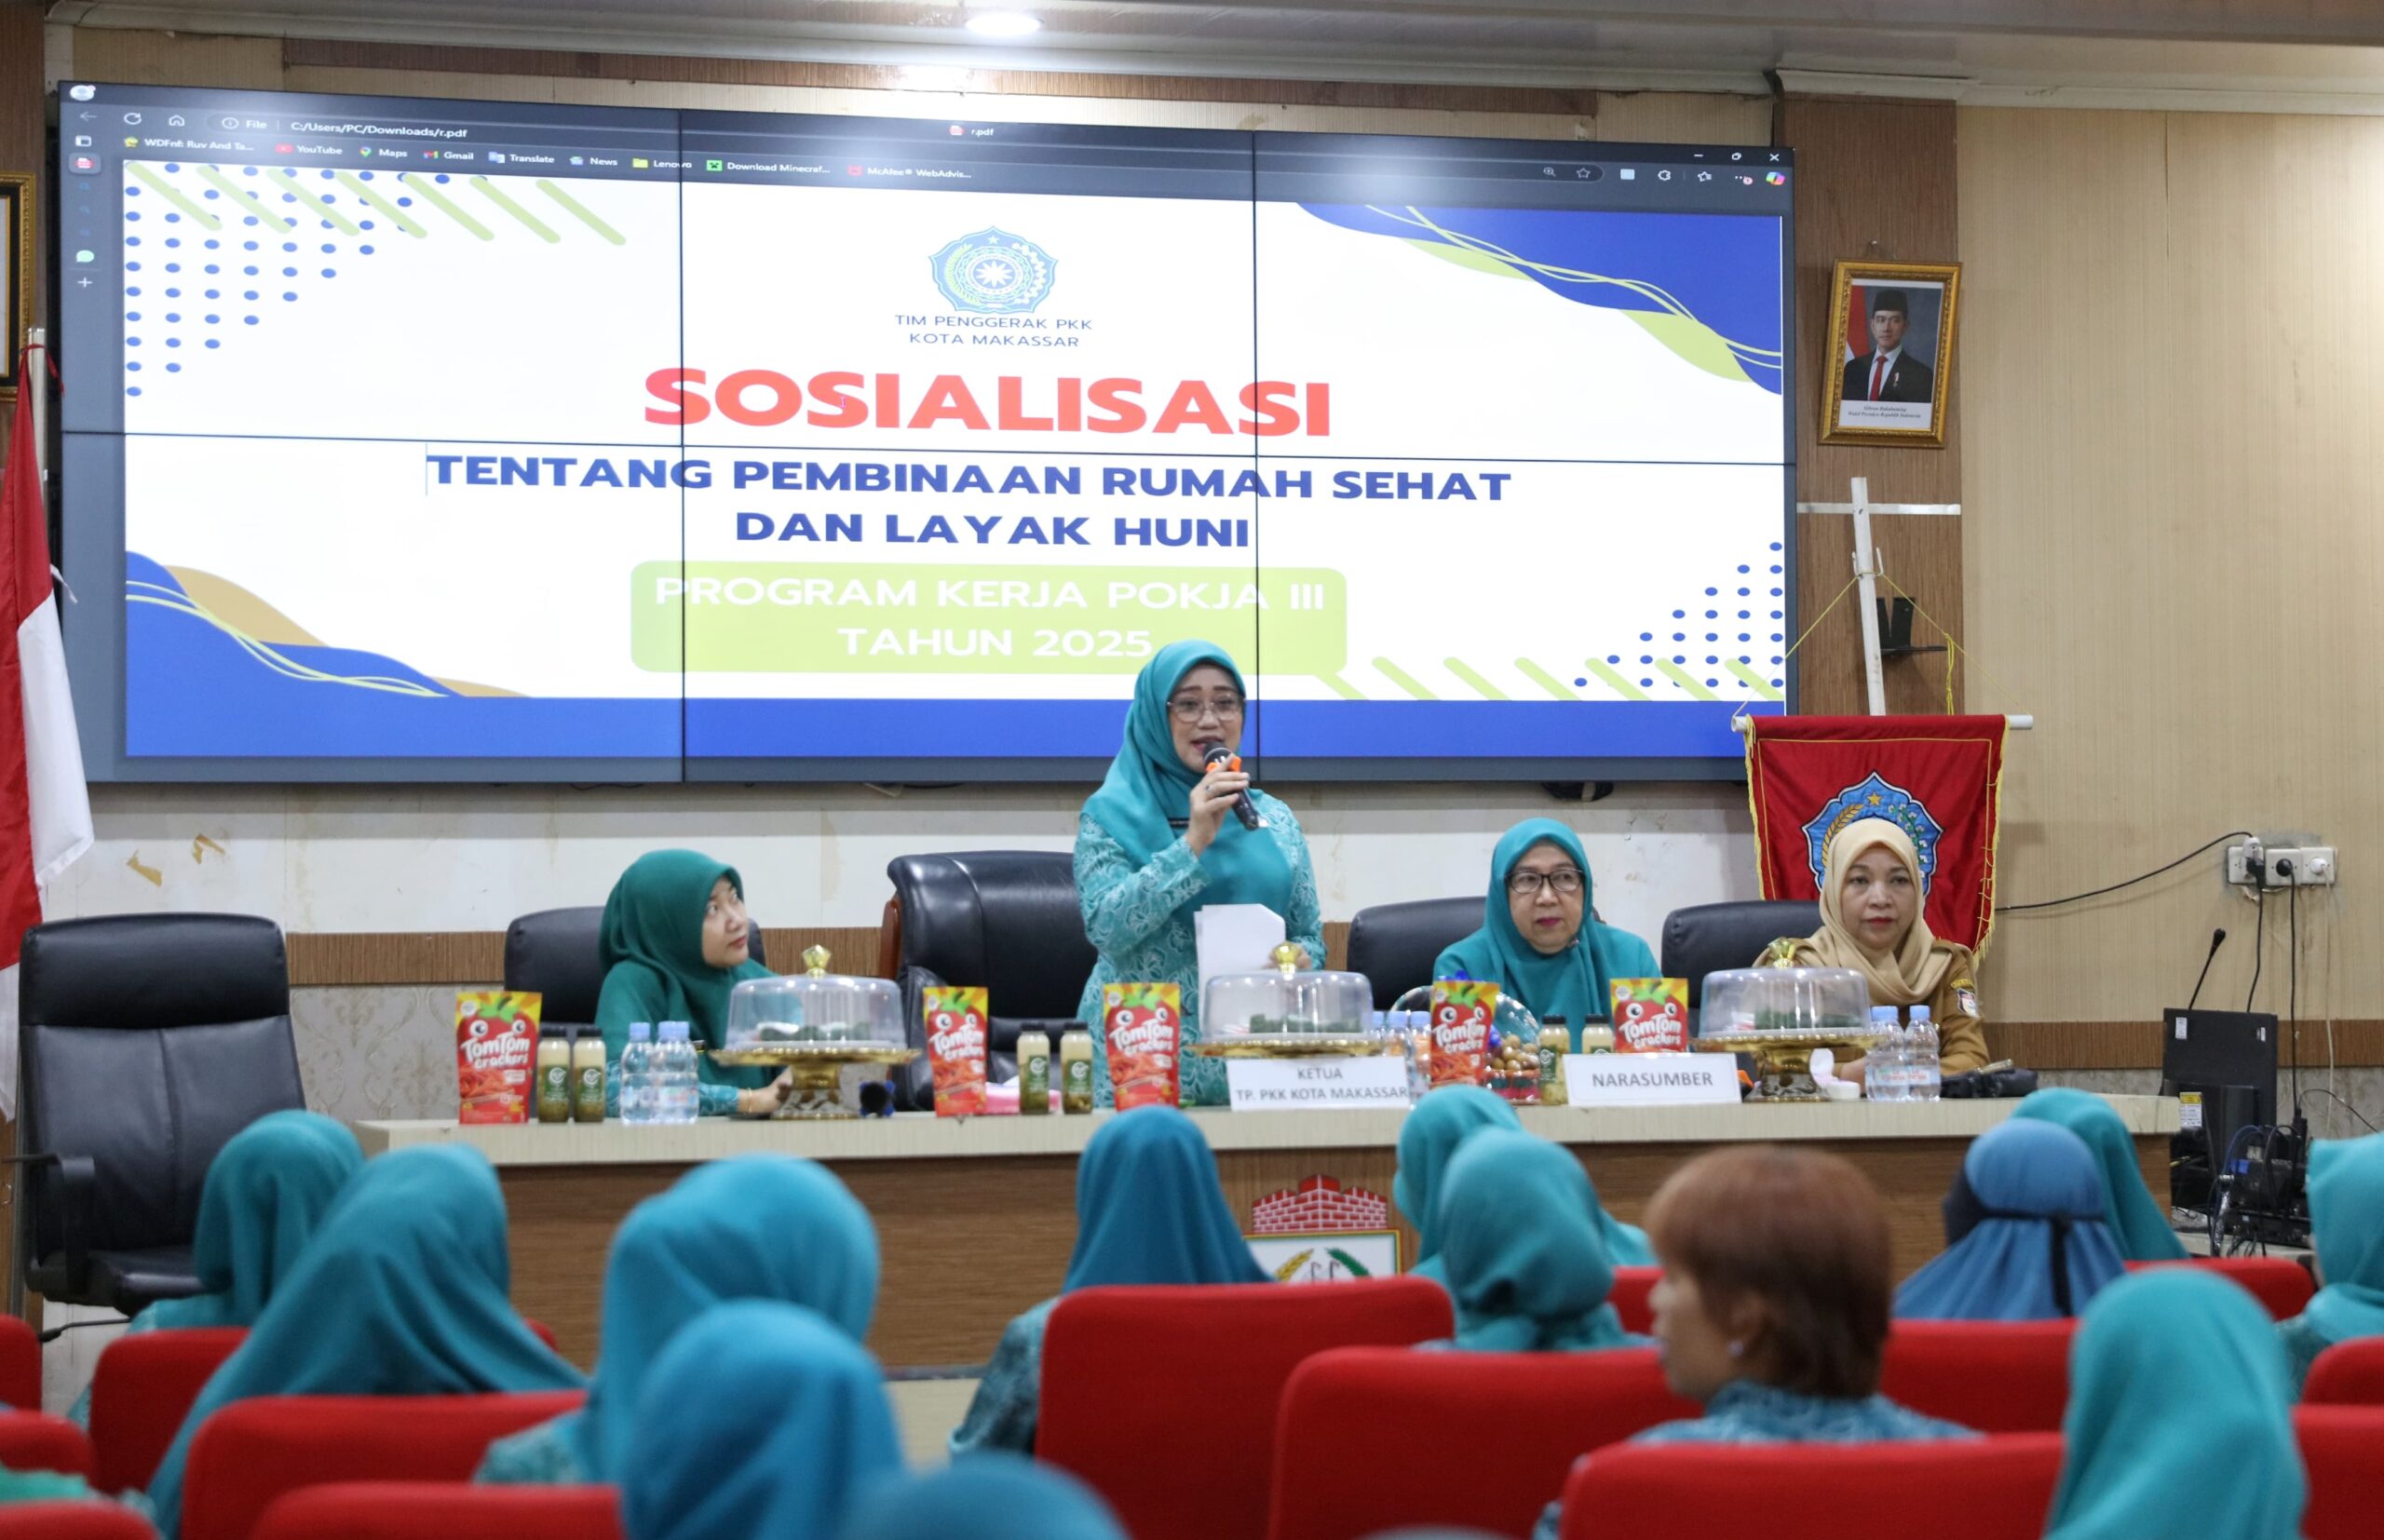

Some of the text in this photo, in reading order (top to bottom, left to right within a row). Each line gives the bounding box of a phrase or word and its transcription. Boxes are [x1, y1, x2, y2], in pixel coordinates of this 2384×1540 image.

[246, 120, 467, 139] File C:/Users/PC/Downloads/r.pdf
[970, 128, 994, 138] r.pdf
[210, 141, 232, 150] And
[297, 145, 343, 155] YouTube
[379, 148, 408, 158] Maps
[443, 151, 474, 160] Gmail
[509, 154, 555, 164] Translate
[589, 156, 618, 167] News
[654, 159, 693, 169] Lenovo
[726, 162, 778, 172] Download
[895, 315, 1092, 330] TIM PENGGERAK PKK
[910, 333, 1079, 347] KOTA MAKASSAR
[644, 368, 1330, 437] SOSIALISASI
[427, 455, 1510, 501] TENTANG PEMBINAAN RUMAH SEHAT
[737, 511, 1249, 547] DAN LAYAK HUNI
[656, 576, 1324, 610] PROGRAM KERJA POKJA III
[837, 628, 1152, 657] TAHUN 2025
[1619, 1013, 1682, 1044] TomTom
[460, 1030, 531, 1063] TomTom
[1297, 1067, 1343, 1080] KETUA
[1592, 1072, 1714, 1087] NARASUMBER
[1237, 1087, 1408, 1101] TP. PKK KOTA MAKASSAR
